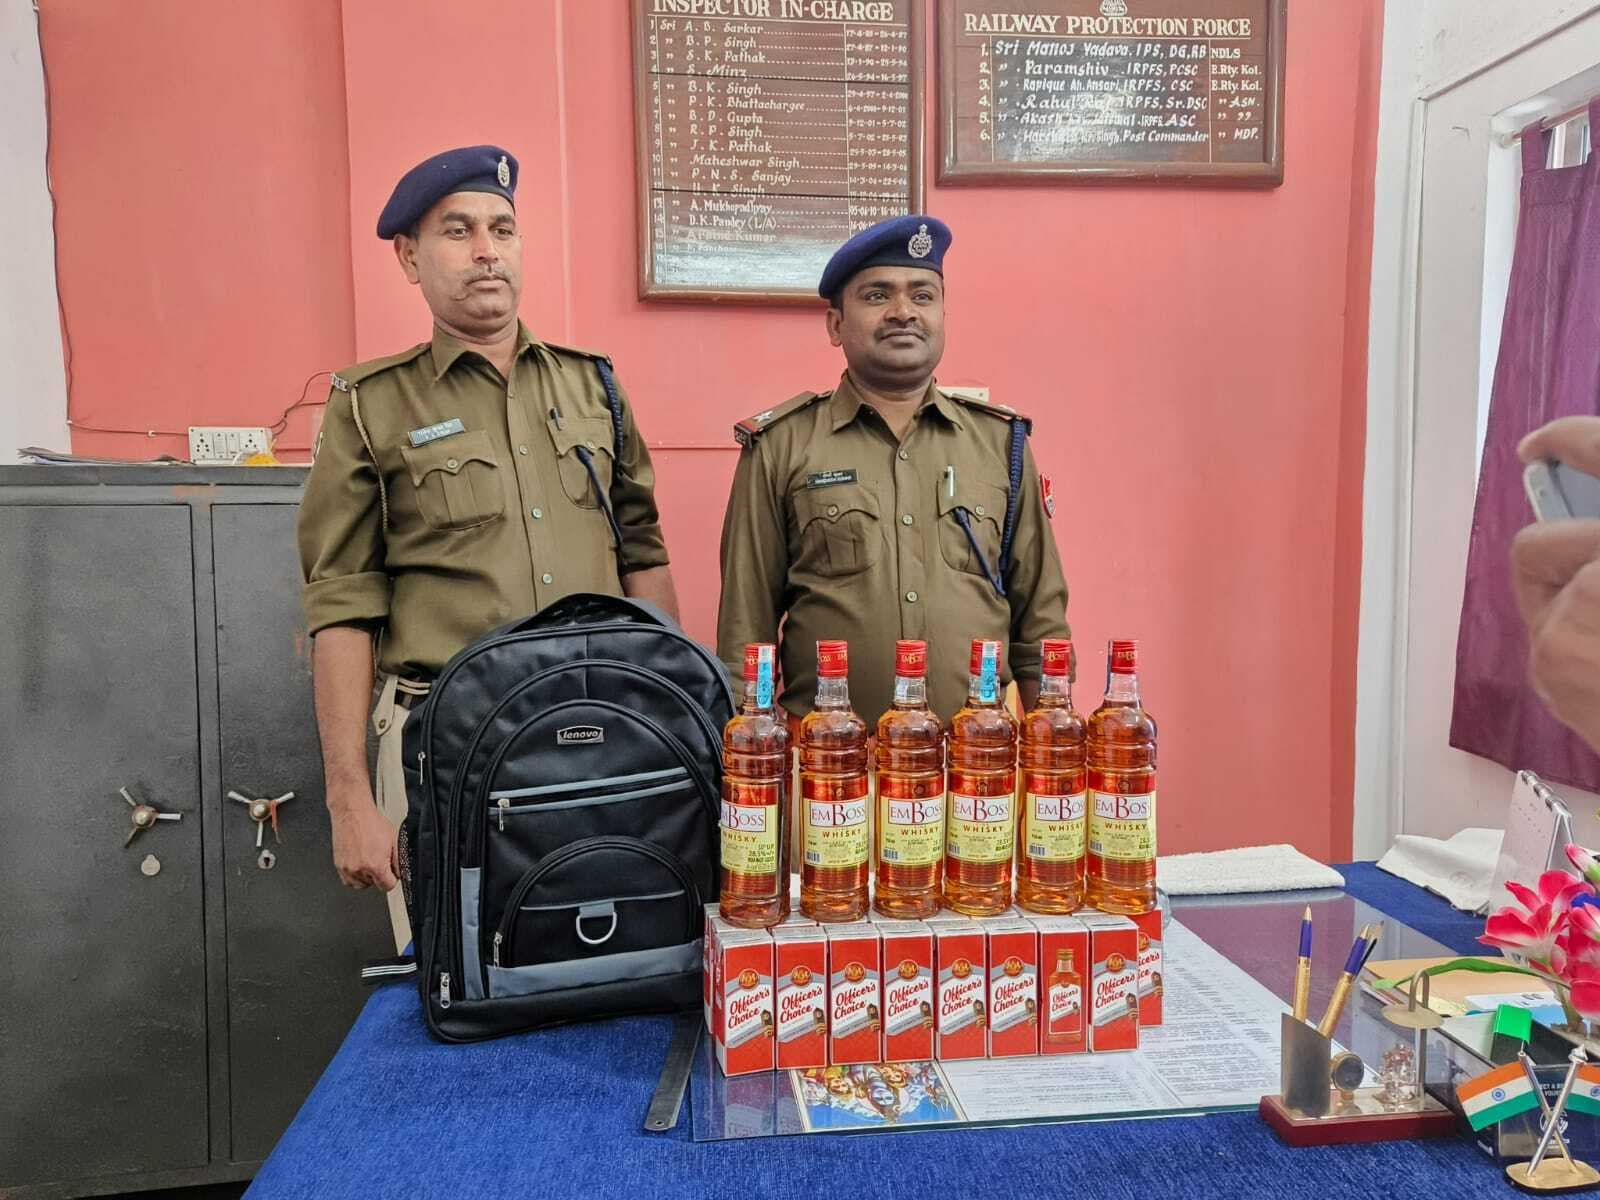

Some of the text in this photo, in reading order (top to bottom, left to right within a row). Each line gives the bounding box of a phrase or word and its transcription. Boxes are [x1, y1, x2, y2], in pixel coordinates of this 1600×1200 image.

[653, 0, 894, 21] INSPECTOR IN-CHARGE
[660, 19, 676, 31] Sri
[724, 22, 764, 34] Sarkar
[964, 13, 1250, 36] RAILWAY PROTECTION FORCE
[724, 37, 757, 51] Singh
[995, 39, 1019, 55] Sri
[1211, 48, 1241, 59] NDLS
[725, 50, 765, 63] Pathak
[1025, 59, 1109, 76] Paramshiv
[726, 82, 762, 98] Singh
[1021, 94, 1075, 109] Rahul
[727, 112, 763, 125] Gupta
[728, 125, 762, 142] Singh
[1148, 130, 1208, 144] Commander
[729, 139, 772, 153] Pathak
[690, 154, 762, 168] Maheshwar
[768, 157, 800, 171] Singh
[752, 170, 792, 186] Sanjay
[731, 183, 765, 201] Singh
[888, 997, 920, 1017] Choice
[942, 996, 973, 1016] Choice
[993, 994, 1025, 1015] Choice
[1095, 990, 1125, 1008] Choice
[728, 1007, 760, 1029] Choice
[780, 1004, 813, 1024] Choice
[834, 1000, 866, 1020] Choice
